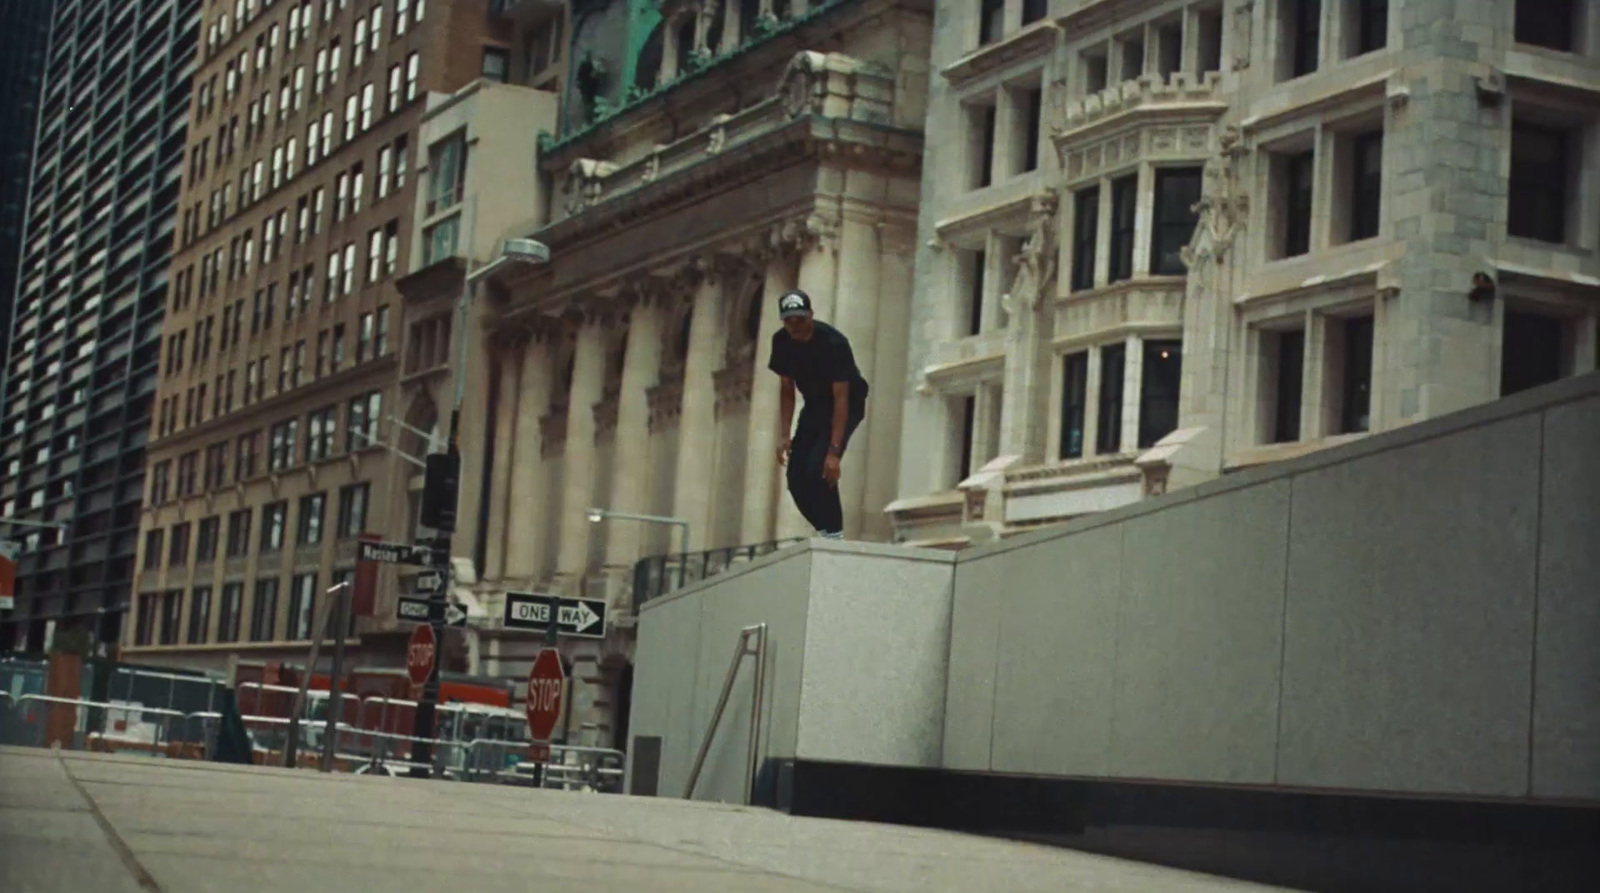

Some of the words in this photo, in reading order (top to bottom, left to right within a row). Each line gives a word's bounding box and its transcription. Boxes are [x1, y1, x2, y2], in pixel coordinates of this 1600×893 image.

[519, 604, 548, 621] ONE
[561, 608, 590, 624] WAY
[408, 643, 434, 667] STOP
[528, 679, 560, 711] STOP
